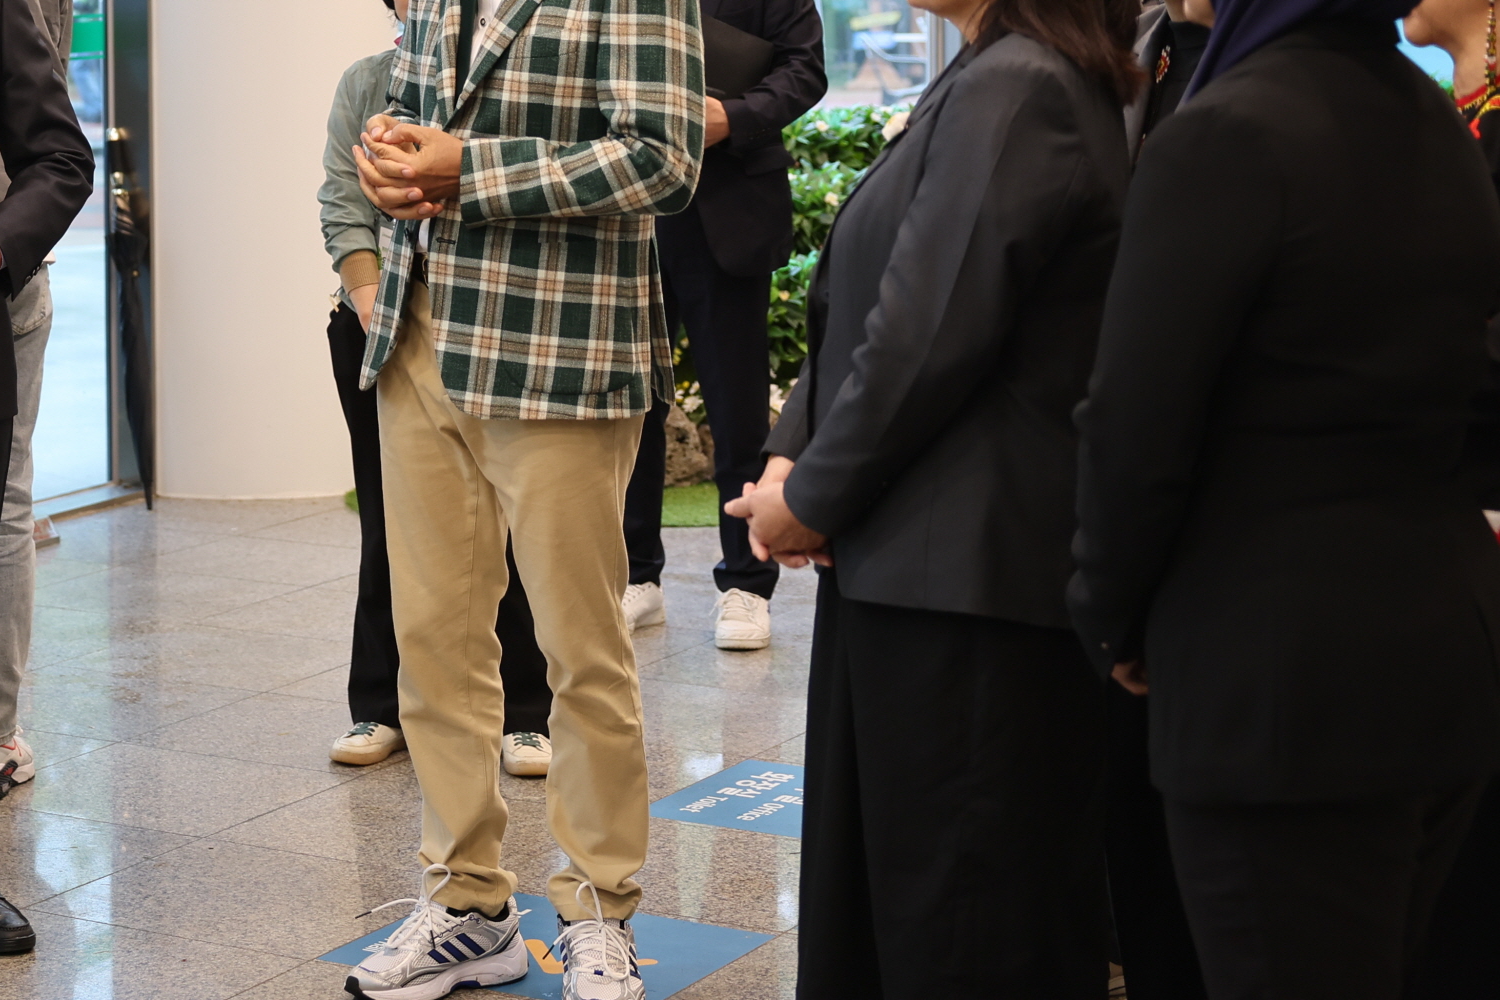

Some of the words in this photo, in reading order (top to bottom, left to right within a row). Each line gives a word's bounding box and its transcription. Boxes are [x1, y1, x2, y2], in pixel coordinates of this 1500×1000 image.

[716, 771, 795, 798] 화장실
[679, 795, 728, 813] Toilet
[736, 802, 785, 821] Office
